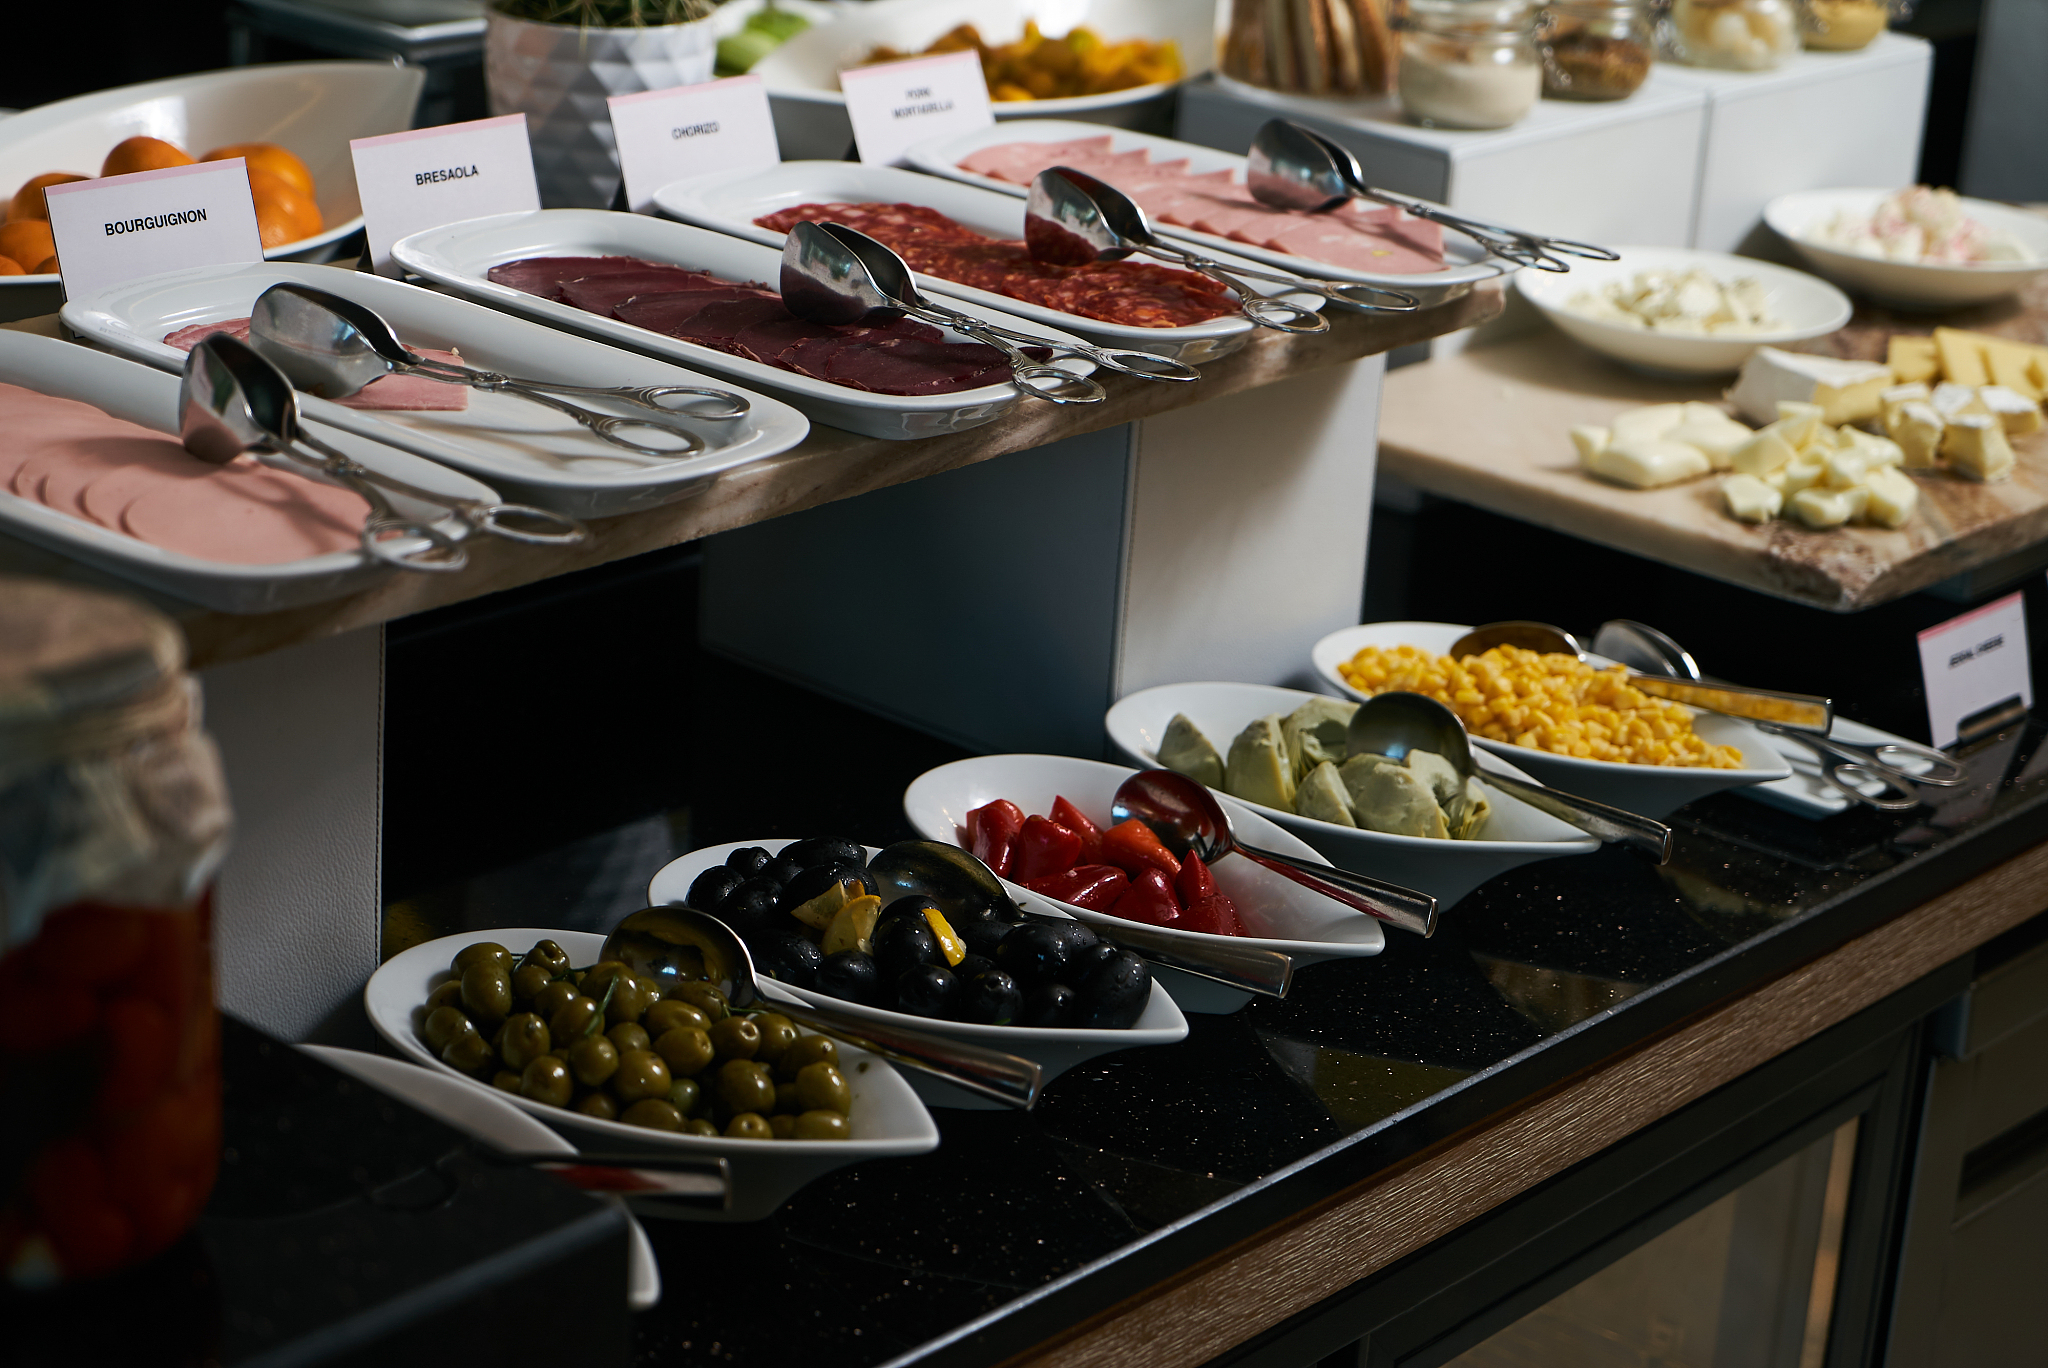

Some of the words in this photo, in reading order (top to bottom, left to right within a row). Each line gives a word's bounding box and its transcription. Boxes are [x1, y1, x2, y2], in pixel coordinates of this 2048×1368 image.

[672, 121, 720, 140] CHORIZO
[415, 165, 479, 186] BRESAOLA
[105, 209, 207, 236] BOURGUIGNON
